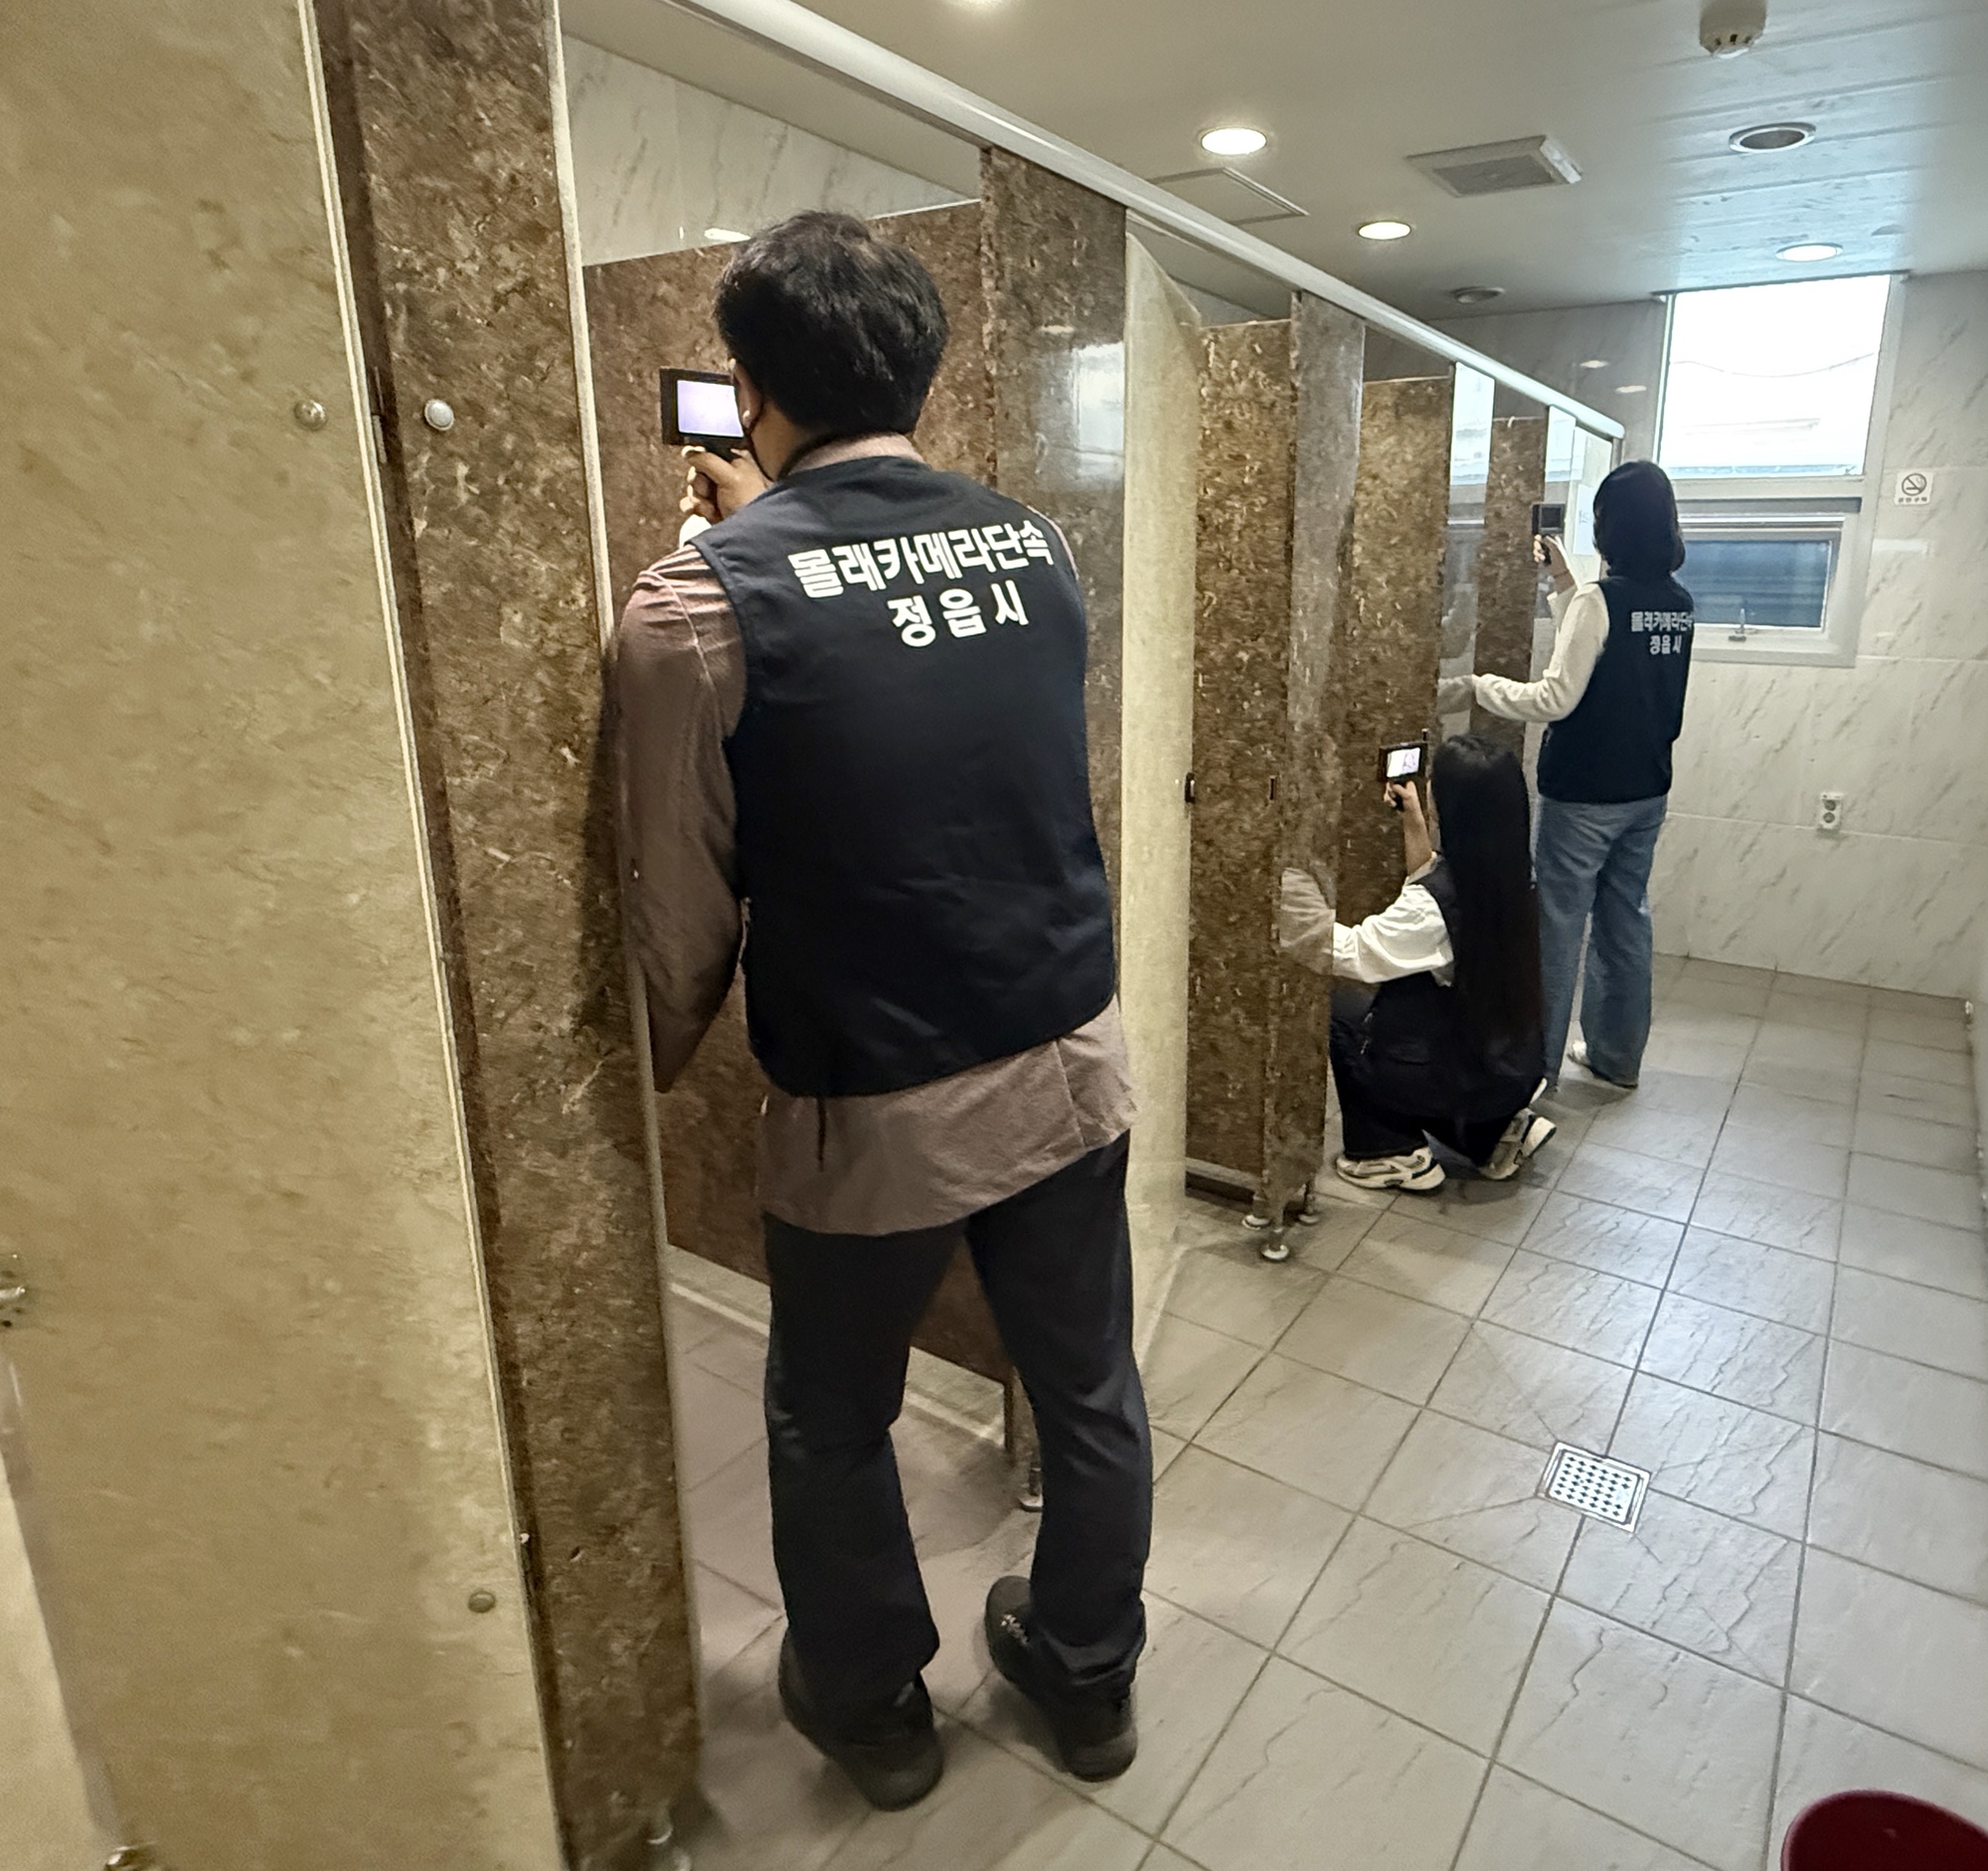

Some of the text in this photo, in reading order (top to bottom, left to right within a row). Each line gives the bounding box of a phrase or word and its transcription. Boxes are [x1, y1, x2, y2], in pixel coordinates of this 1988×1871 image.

[787, 520, 1055, 597] 몰래카메라단속
[888, 580, 1029, 647] 정읍시
[1649, 634, 1682, 655] 정읍시
